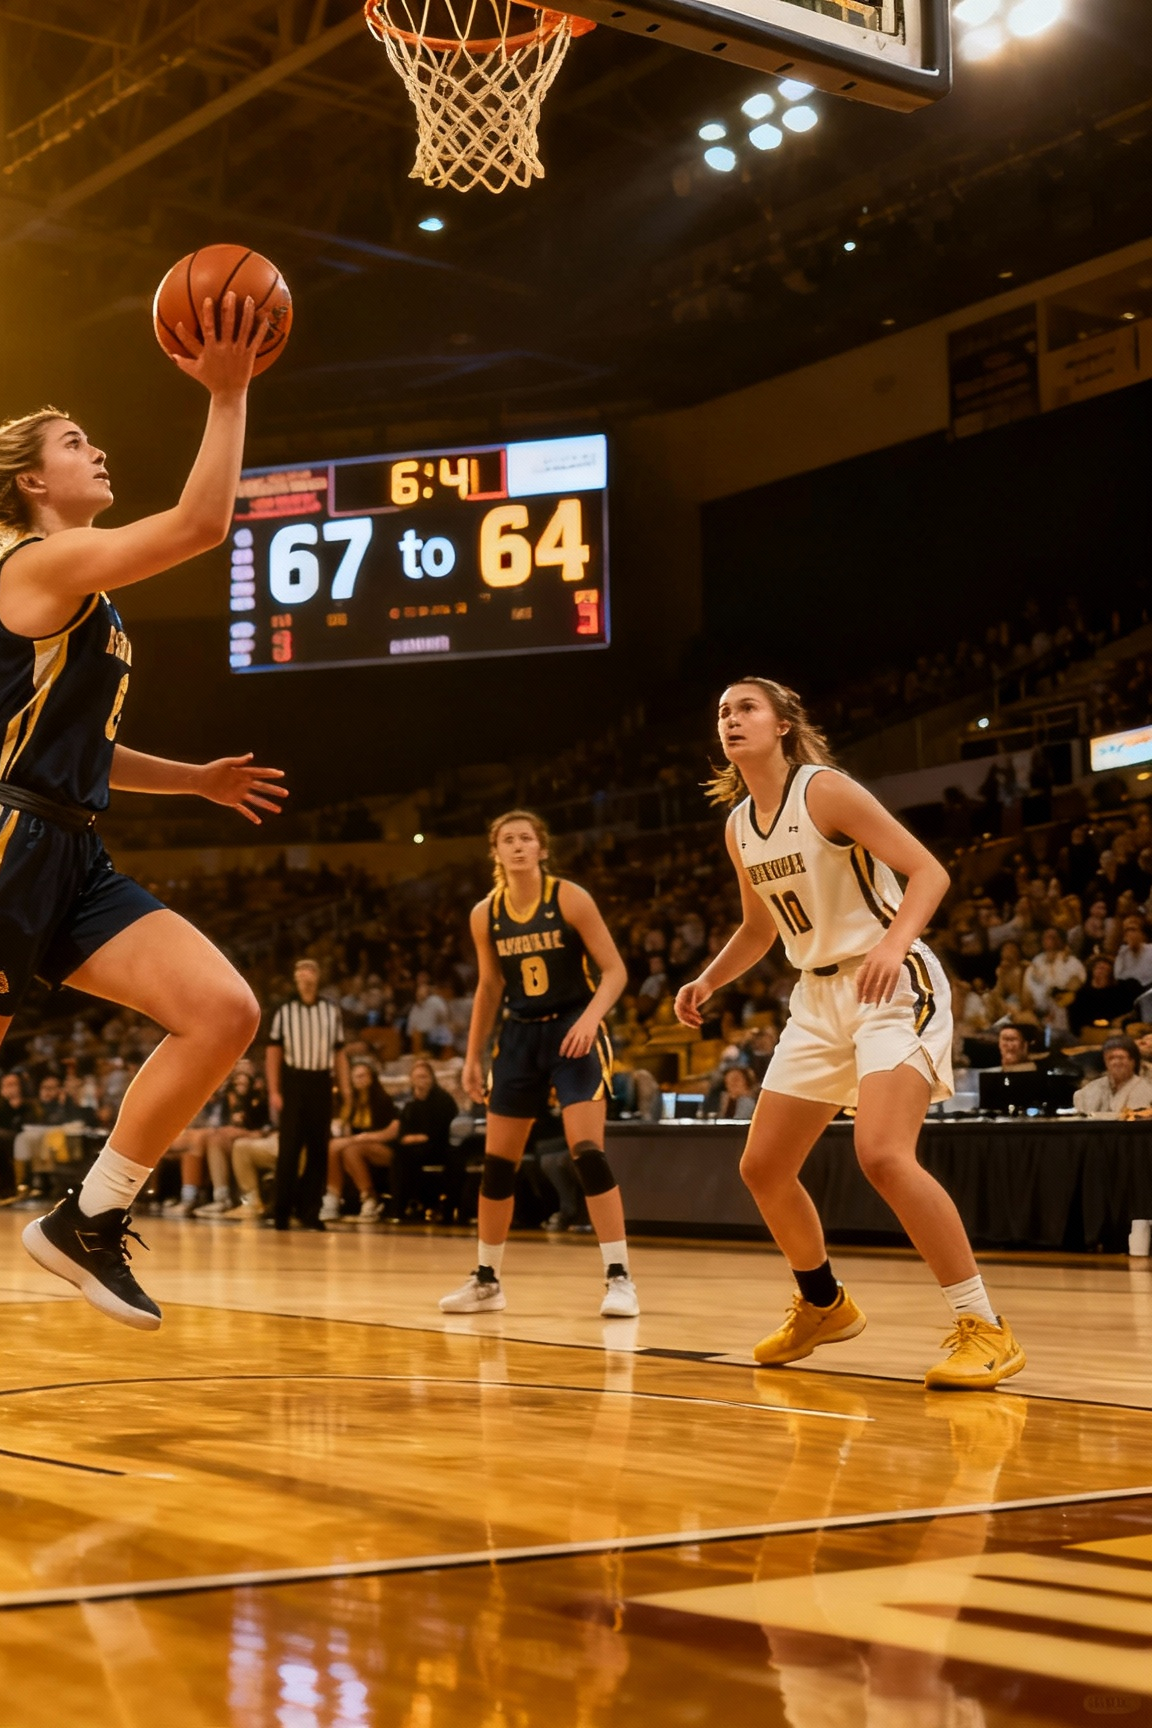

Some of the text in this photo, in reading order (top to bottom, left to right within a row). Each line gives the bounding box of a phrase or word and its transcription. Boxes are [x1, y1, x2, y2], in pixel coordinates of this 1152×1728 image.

[269, 516, 373, 604] 67
[398, 529, 456, 580] to
[479, 498, 590, 588] 64
[770, 890, 814, 936] 10
